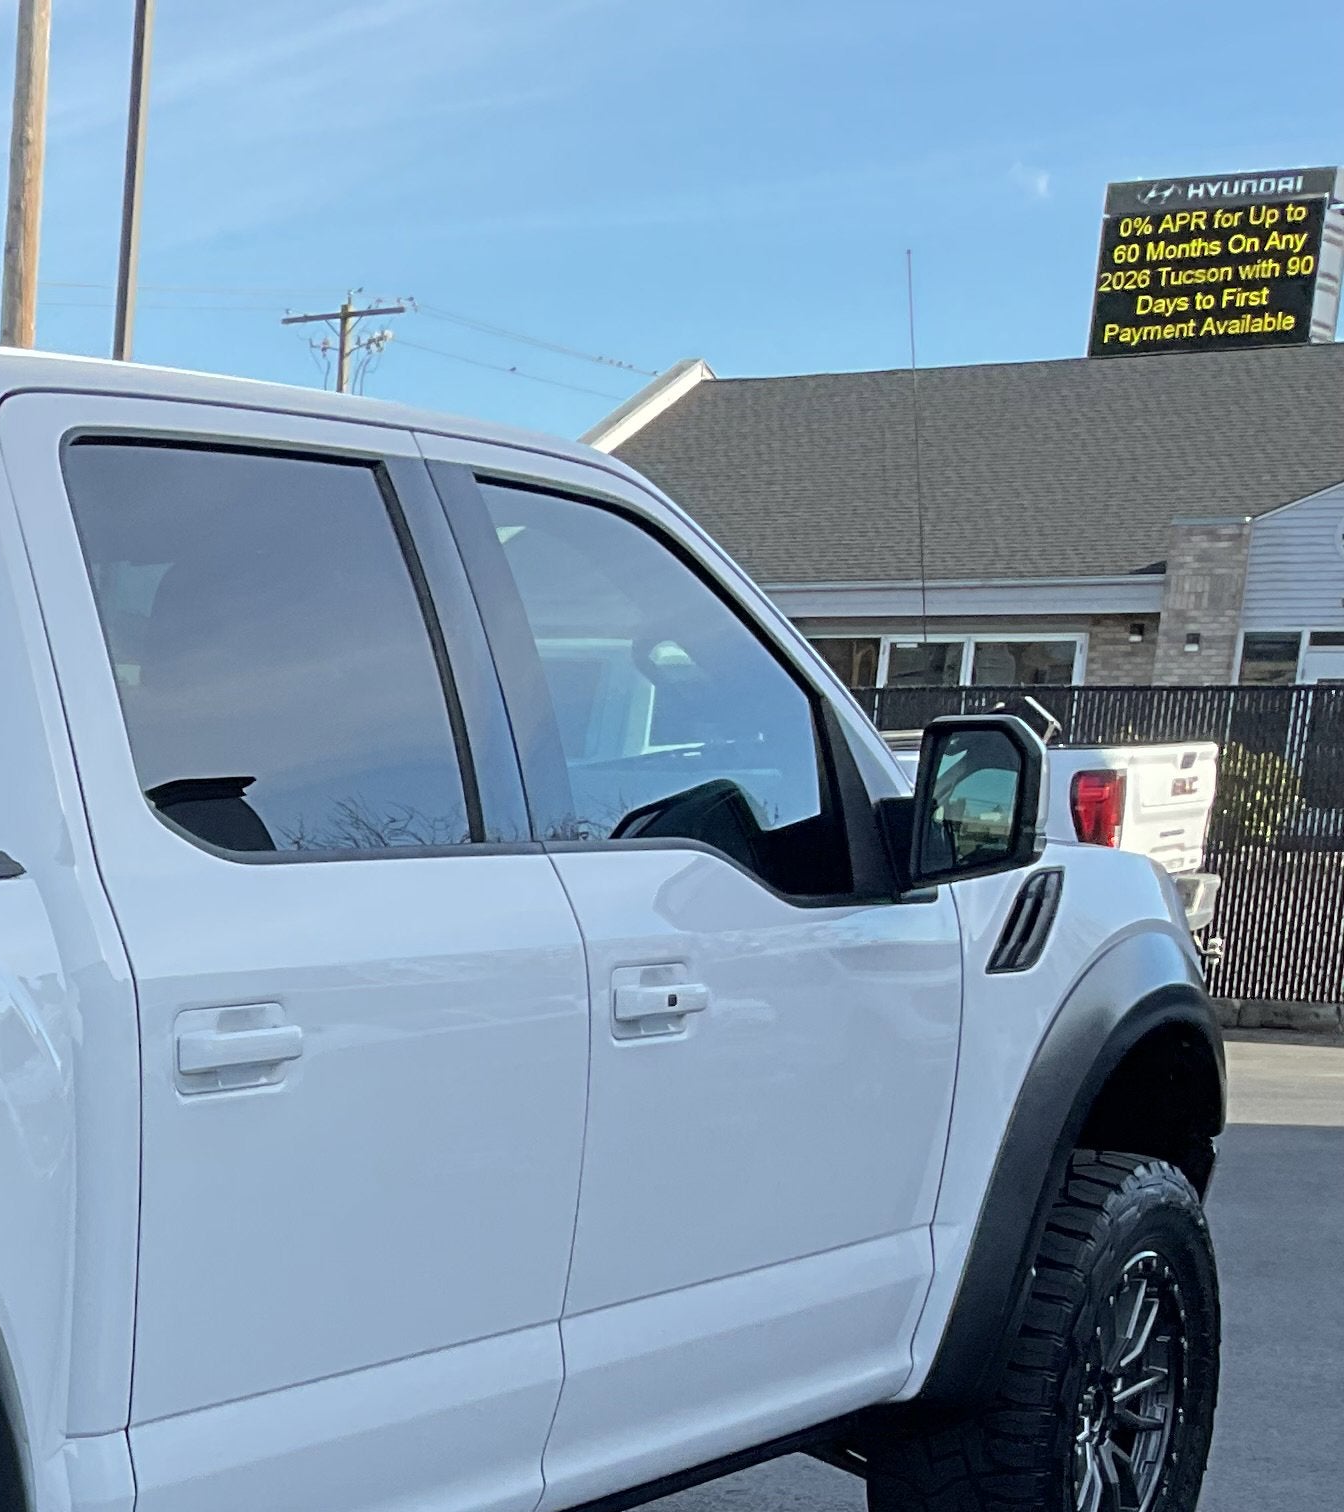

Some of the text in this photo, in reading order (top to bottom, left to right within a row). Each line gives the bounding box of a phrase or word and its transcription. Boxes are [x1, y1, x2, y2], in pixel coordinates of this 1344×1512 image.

[1188, 176, 1303, 199] HYUNDAI
[1119, 203, 1308, 238] 0% APR for Up to
[1113, 230, 1309, 265] 60 Months On Any
[1097, 255, 1315, 293] 2026 Tucson with 90
[1136, 286, 1270, 318] Days to First
[1103, 311, 1296, 346] Payment Available
